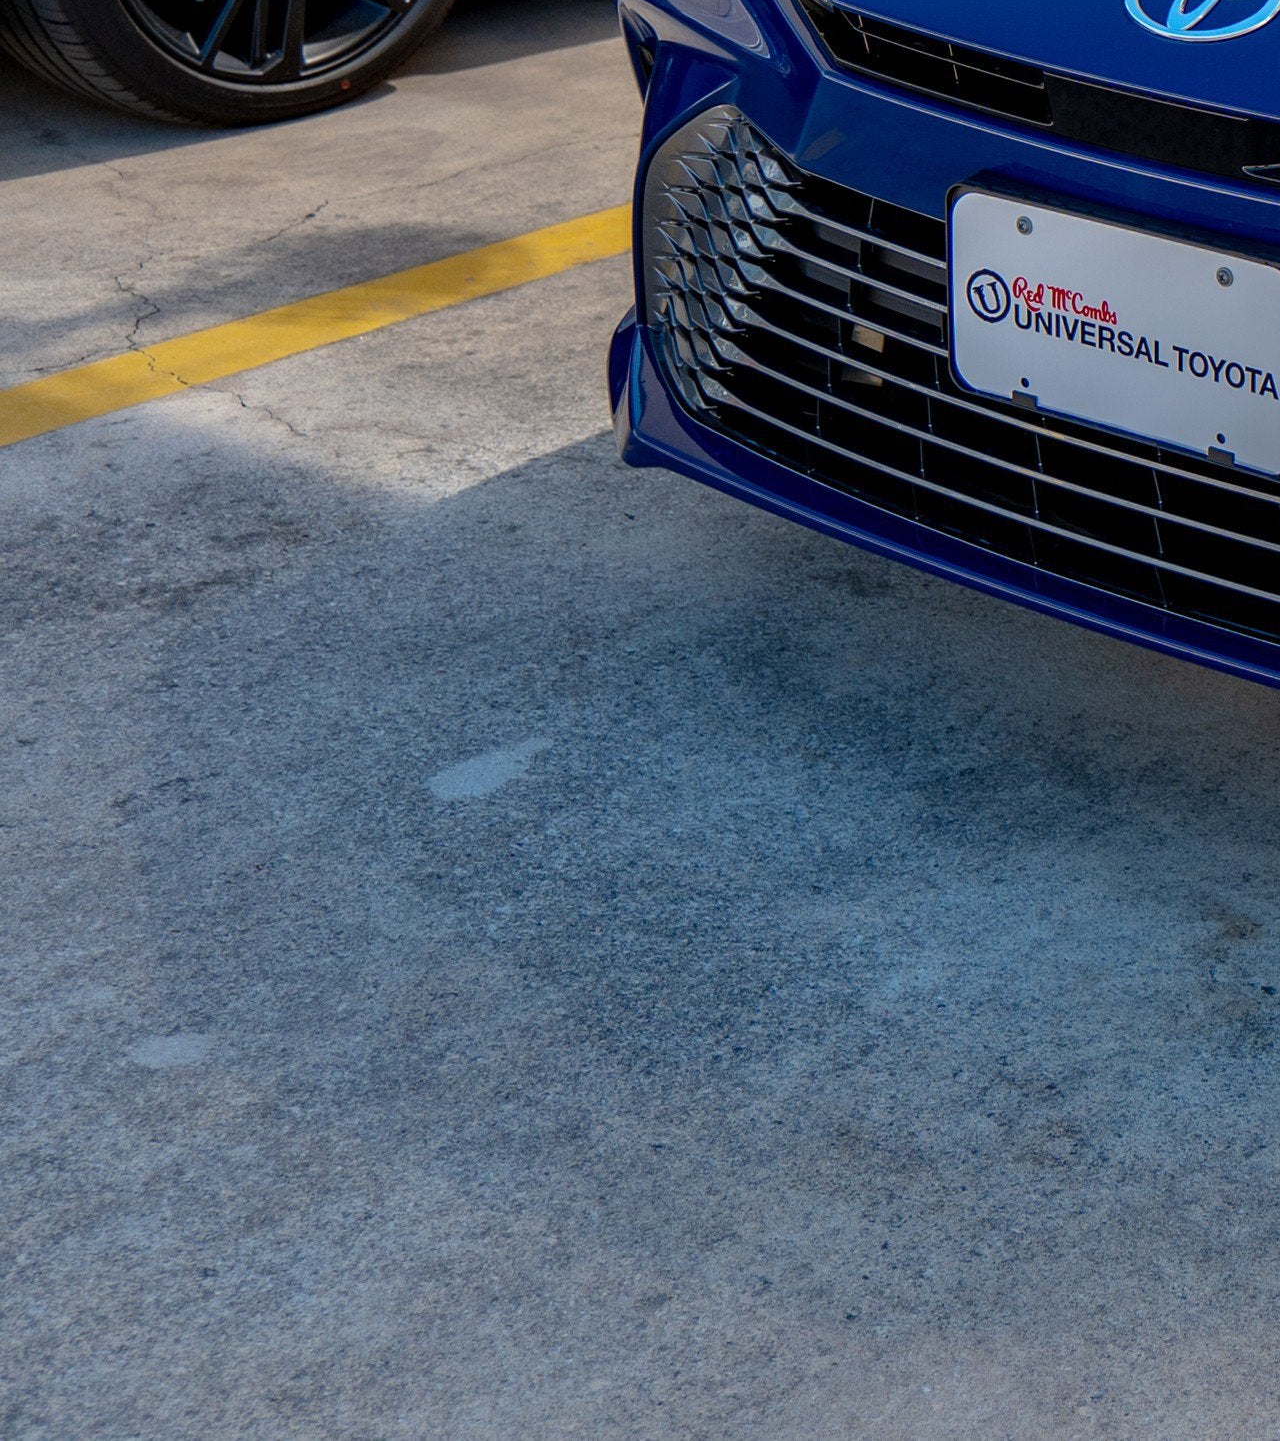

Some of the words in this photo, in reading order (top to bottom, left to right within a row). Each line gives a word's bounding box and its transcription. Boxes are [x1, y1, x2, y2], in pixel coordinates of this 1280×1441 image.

[1012, 276, 1045, 313] Red
[1046, 284, 1118, 326] McCombs
[1014, 303, 1170, 369] UNIVERSAL
[1172, 345, 1280, 401] TOYOTA
